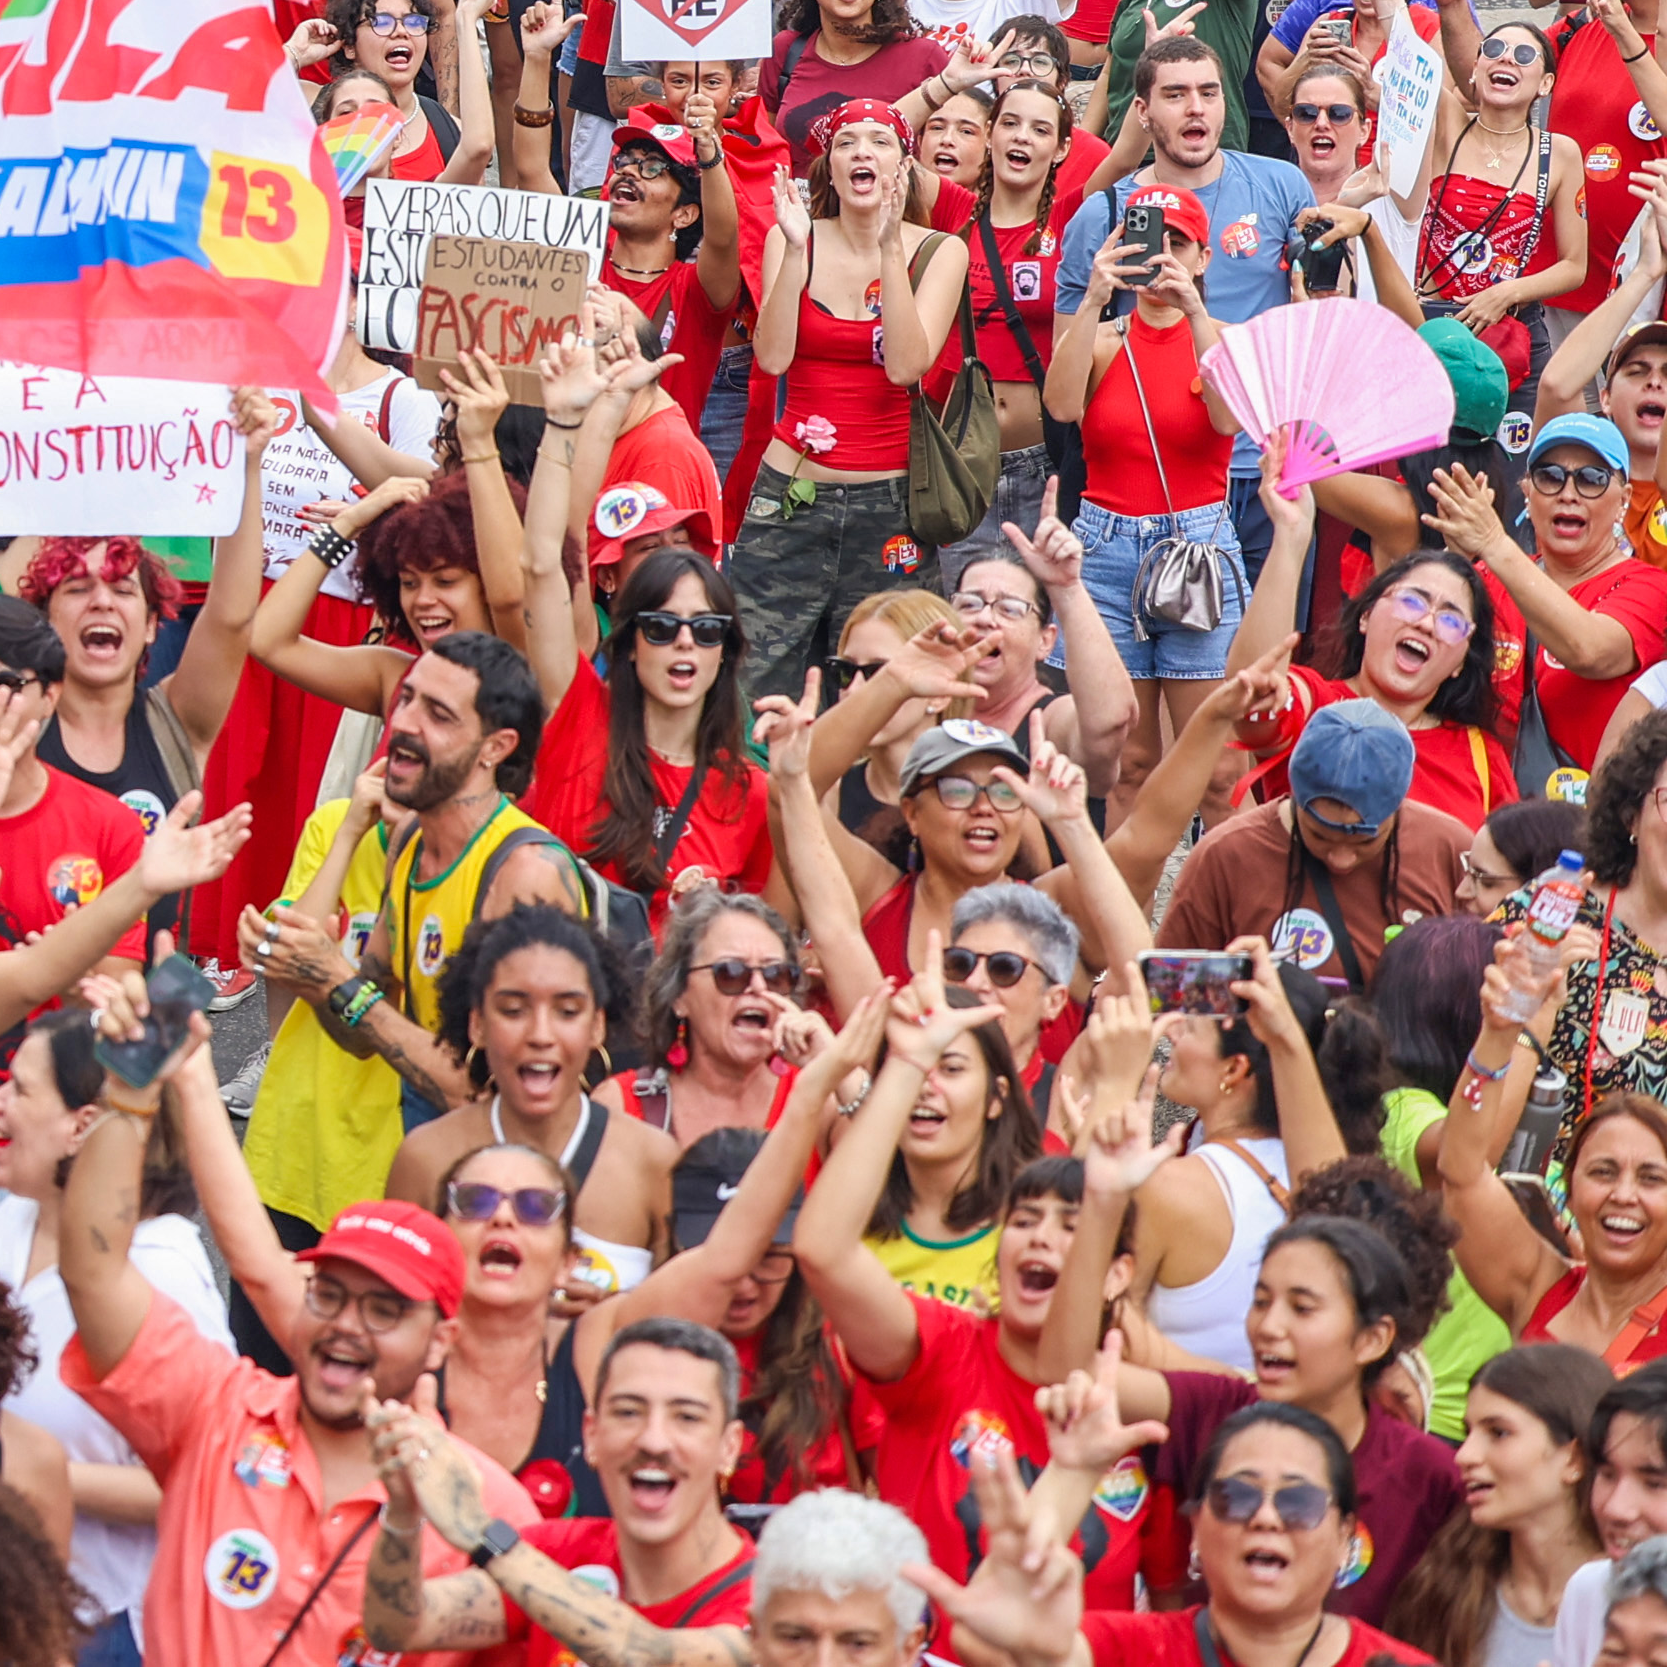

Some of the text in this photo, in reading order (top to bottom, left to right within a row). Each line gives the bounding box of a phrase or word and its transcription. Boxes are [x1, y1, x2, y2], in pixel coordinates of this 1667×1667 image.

[217, 163, 298, 245] 13
[1534, 172, 1549, 214] TOMMY
[372, 184, 606, 250] VERÁS QUE UM
[433, 239, 590, 276] ESTUDANTES
[473, 272, 564, 293] CONTRA O
[414, 284, 583, 368] FASCISMO
[74, 372, 108, 411] A
[1507, 424, 1531, 443] 13
[294, 444, 339, 466] NAÇÃO
[267, 480, 296, 499] SEM
[611, 500, 639, 525] 13
[1288, 926, 1328, 955] 13
[226, 1550, 271, 1594] 13
